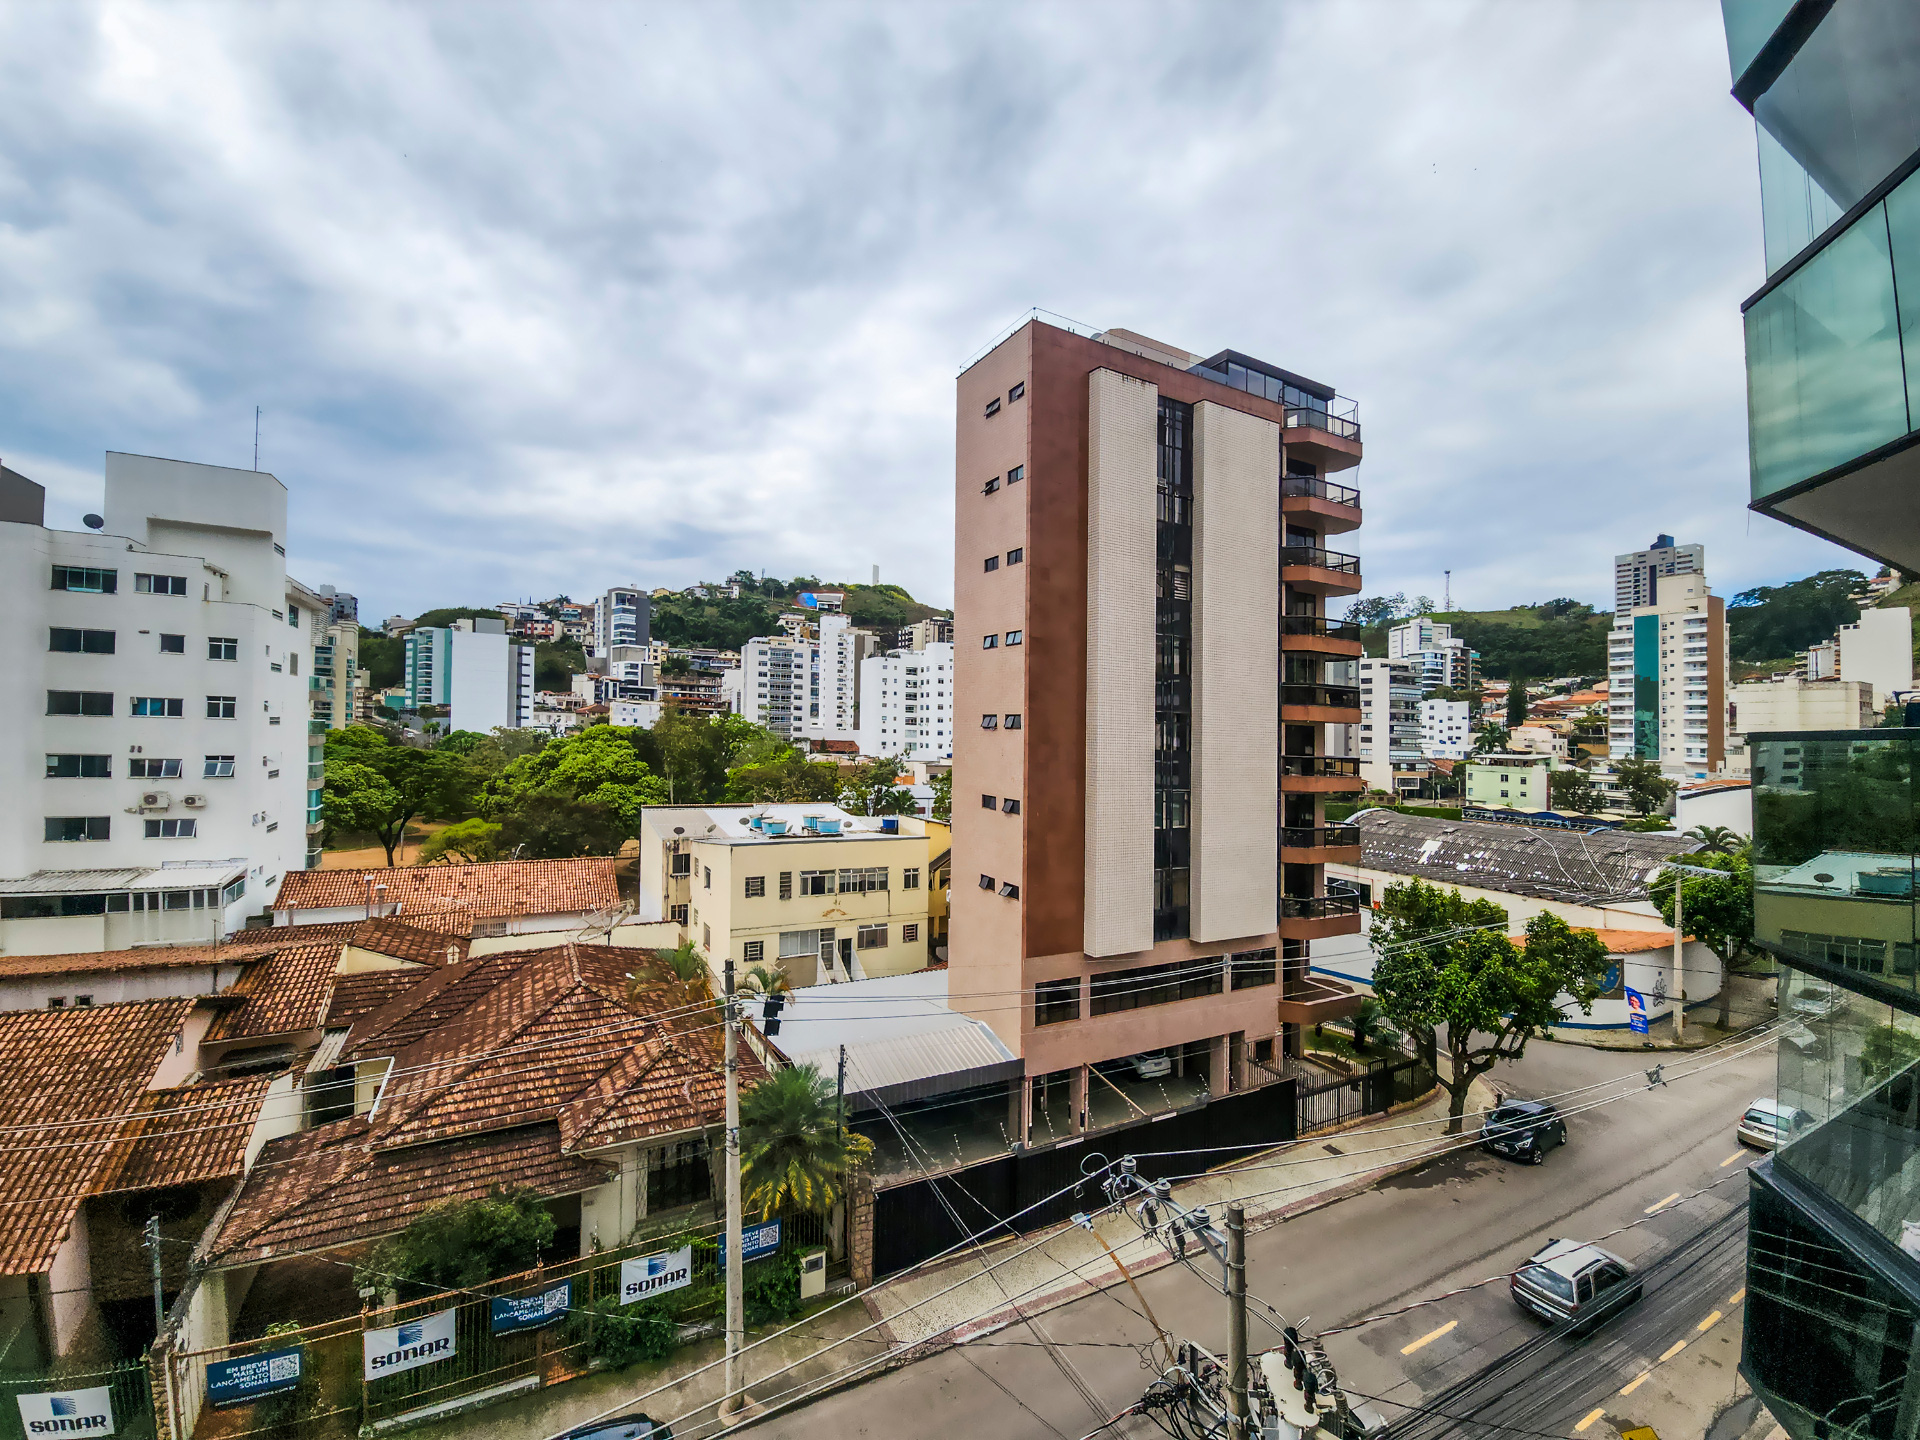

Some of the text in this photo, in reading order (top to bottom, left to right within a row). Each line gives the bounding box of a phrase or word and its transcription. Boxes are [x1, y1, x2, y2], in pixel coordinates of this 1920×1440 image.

[625, 1267, 688, 1296] SONAR
[371, 1337, 450, 1370] SONAR
[226, 1360, 268, 1375] EM BREVE
[233, 1365, 269, 1378] MAIS UM
[239, 1378, 269, 1390] SONAR
[29, 1414, 107, 1433] SONAR
